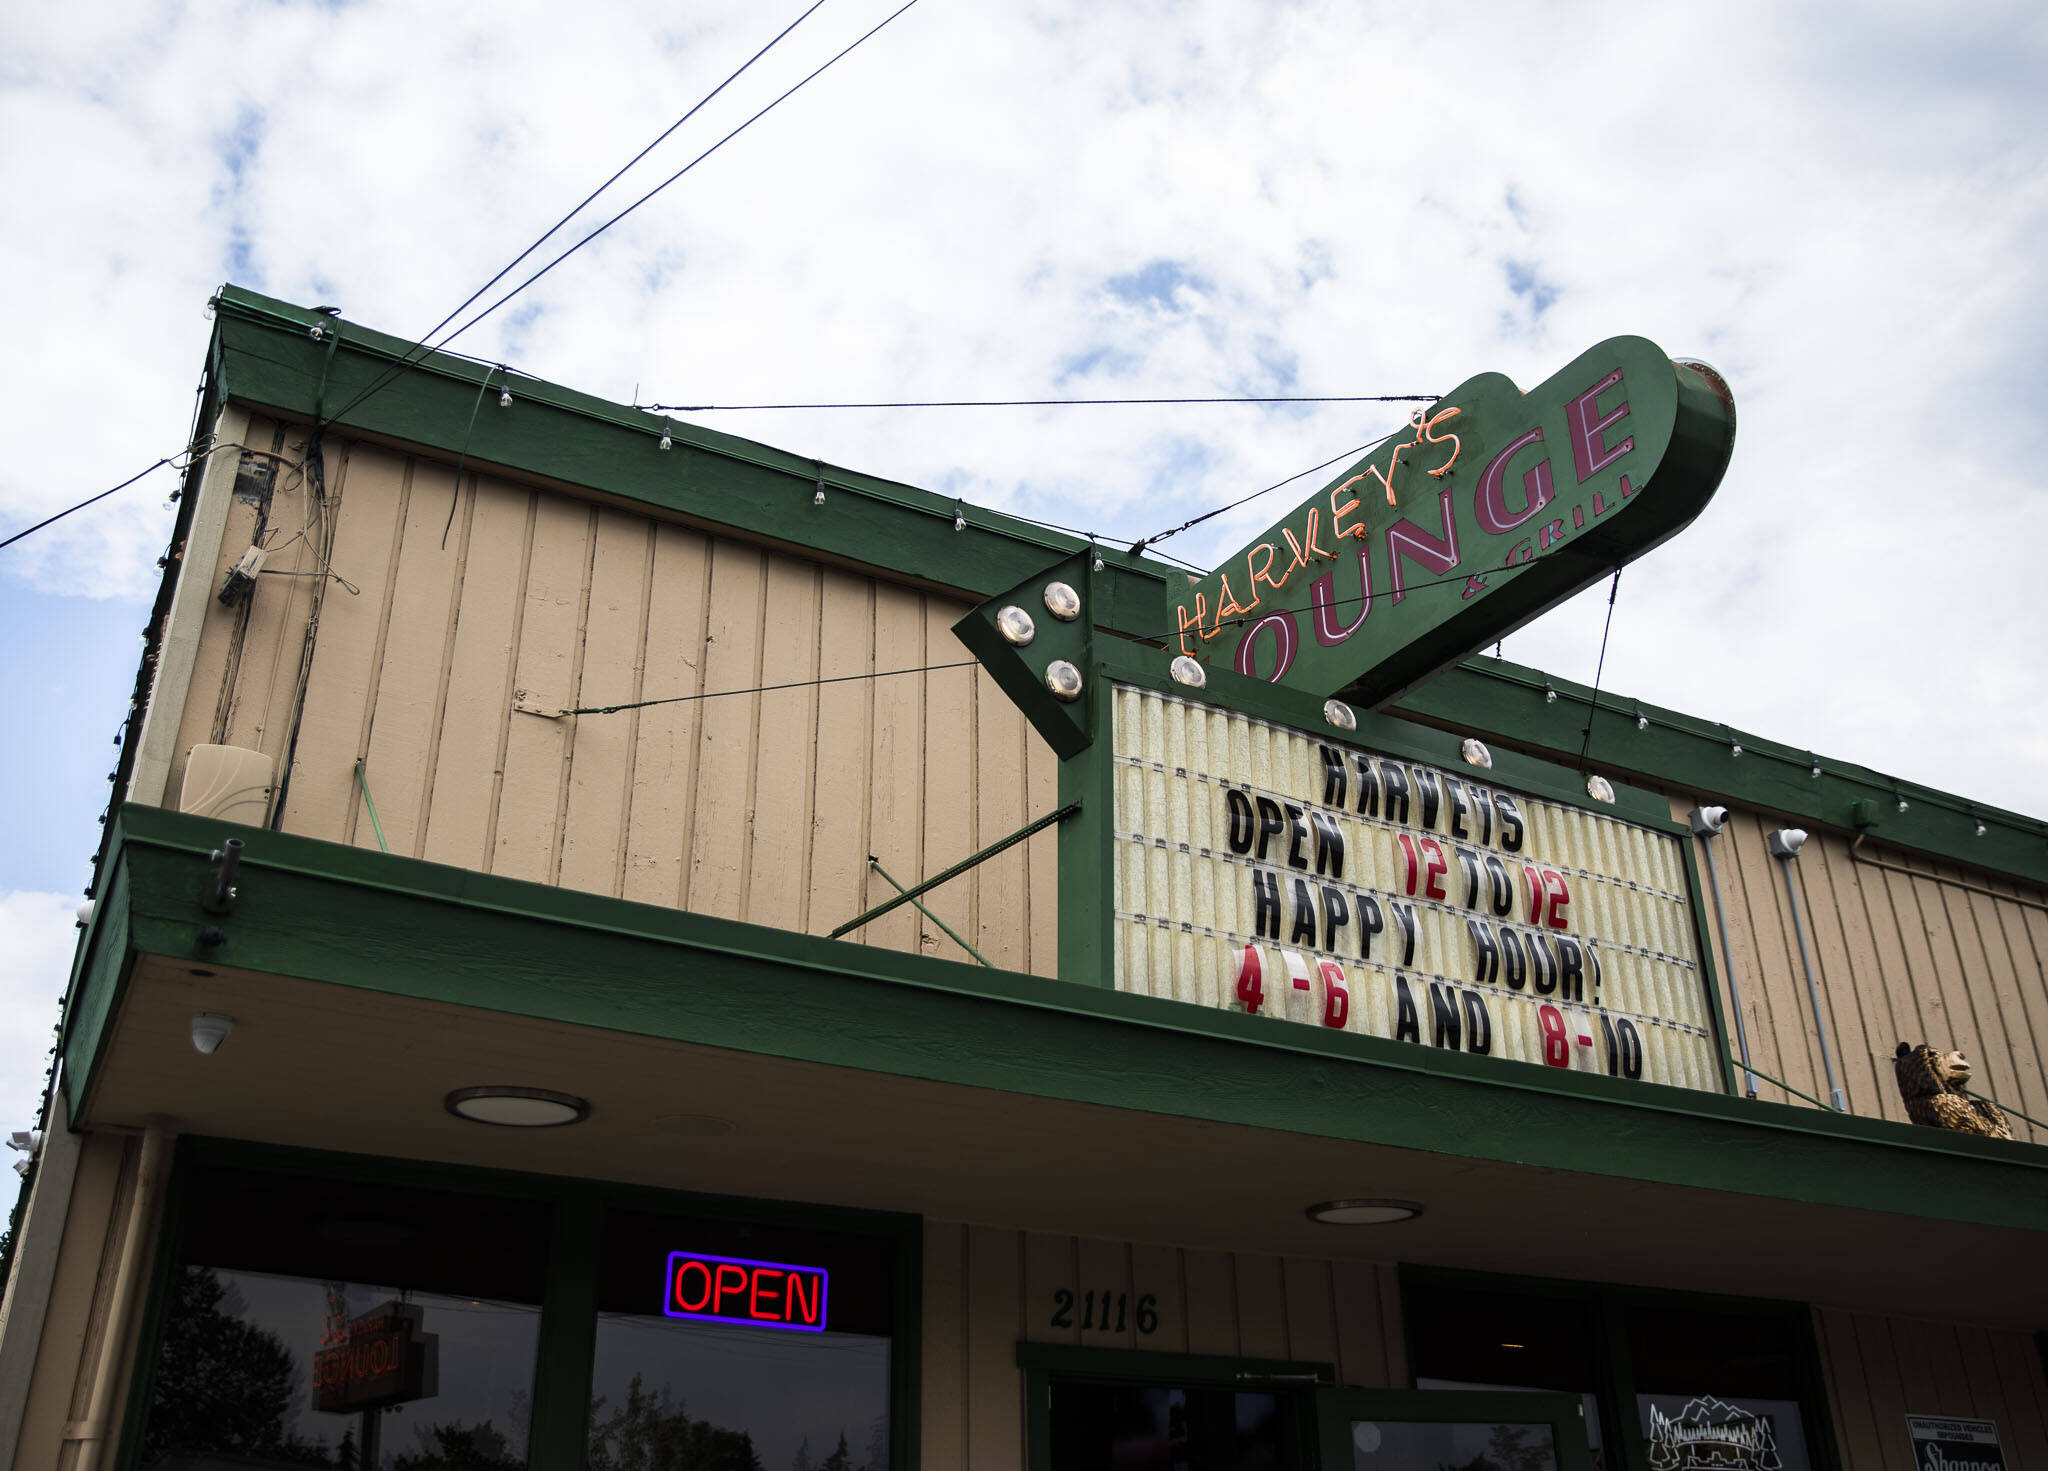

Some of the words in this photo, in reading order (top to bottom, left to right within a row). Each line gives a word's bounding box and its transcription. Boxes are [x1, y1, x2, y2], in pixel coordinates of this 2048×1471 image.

[1177, 406, 1461, 657] HARVEY'S
[1203, 366, 1634, 684] OUNGE
[1504, 473, 1643, 568] GRILL
[1318, 744, 1524, 853] HARVEYS
[1226, 788, 1346, 878] OPEN
[1399, 833, 1447, 901] 12
[1455, 846, 1514, 917] TO
[1525, 865, 1570, 930] 12
[1253, 867, 1416, 967] HAPPY
[1468, 918, 1601, 1006] HOUR!
[1396, 975, 1491, 1056] AND
[674, 1260, 820, 1325] OPEN
[1050, 1287, 1158, 1335] 21116
